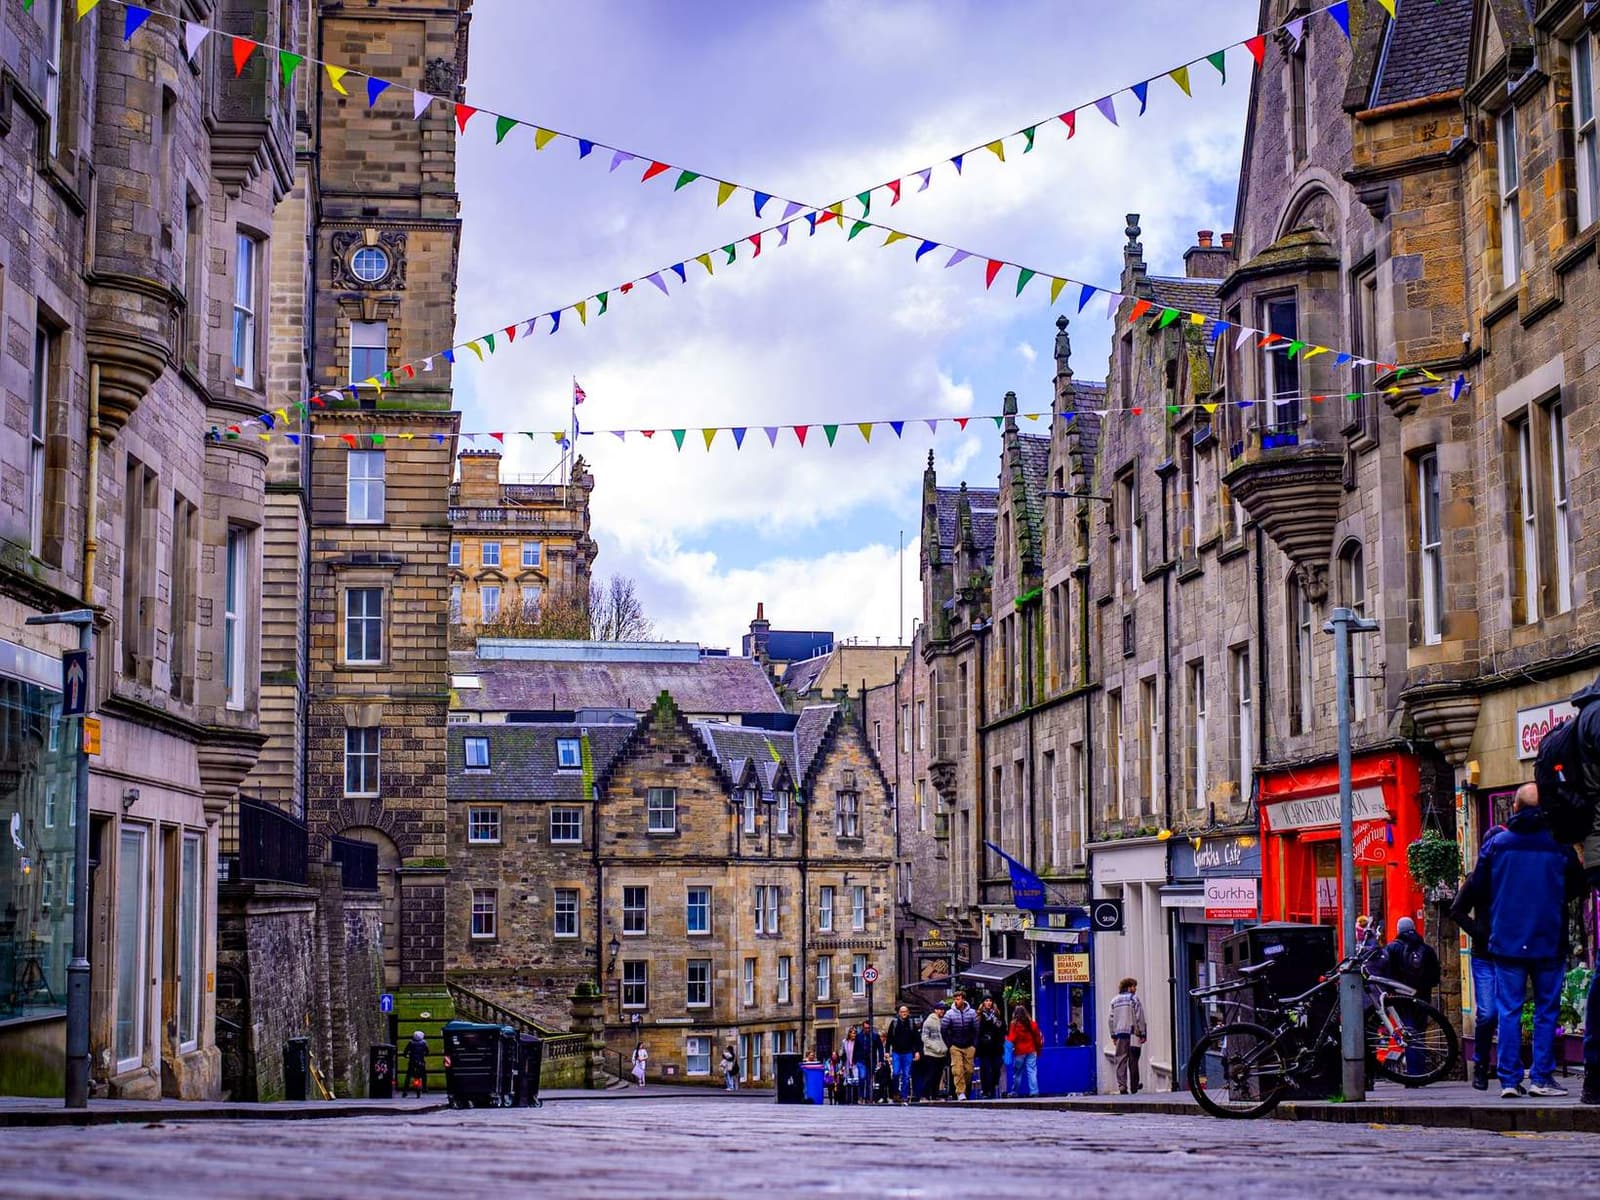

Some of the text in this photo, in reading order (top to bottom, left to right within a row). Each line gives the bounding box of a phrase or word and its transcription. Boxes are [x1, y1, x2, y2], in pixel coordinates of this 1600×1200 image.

[1193, 842, 1220, 877] Gurkha
[1208, 886, 1255, 900] Gurkha
[865, 971, 876, 979] 20
